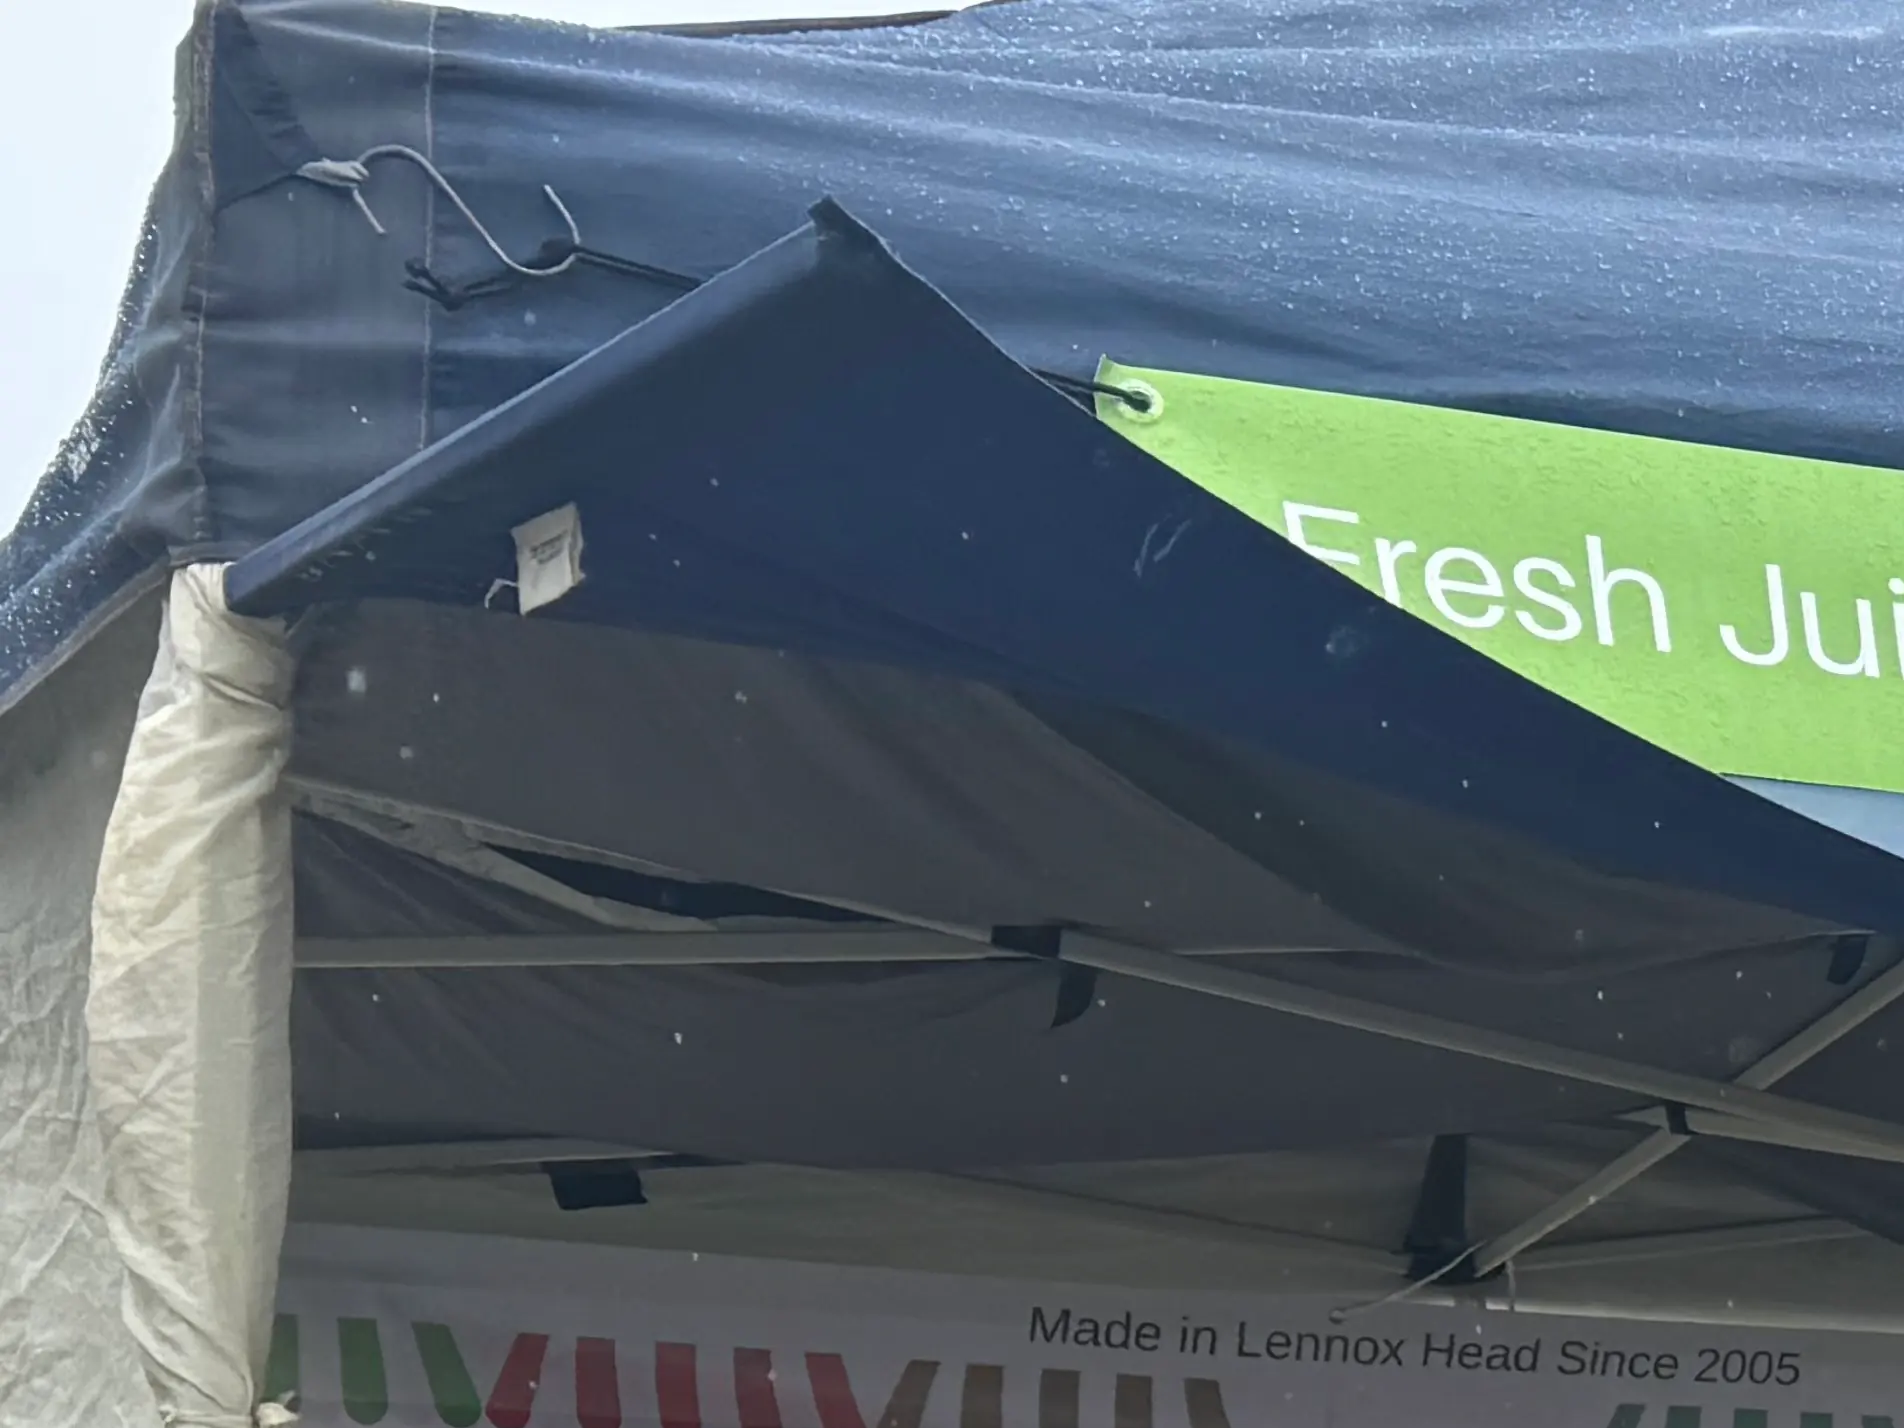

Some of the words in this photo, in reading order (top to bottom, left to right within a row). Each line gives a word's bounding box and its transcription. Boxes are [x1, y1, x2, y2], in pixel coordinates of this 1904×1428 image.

[1282, 500, 1672, 653] Fresh
[1030, 1307, 1161, 1351] Made
[1180, 1316, 1217, 1355] in
[1238, 1317, 1404, 1366] Lennox
[1423, 1333, 1541, 1372] Head
[1557, 1341, 1678, 1379] Since
[1694, 1349, 1800, 1385] 2005
